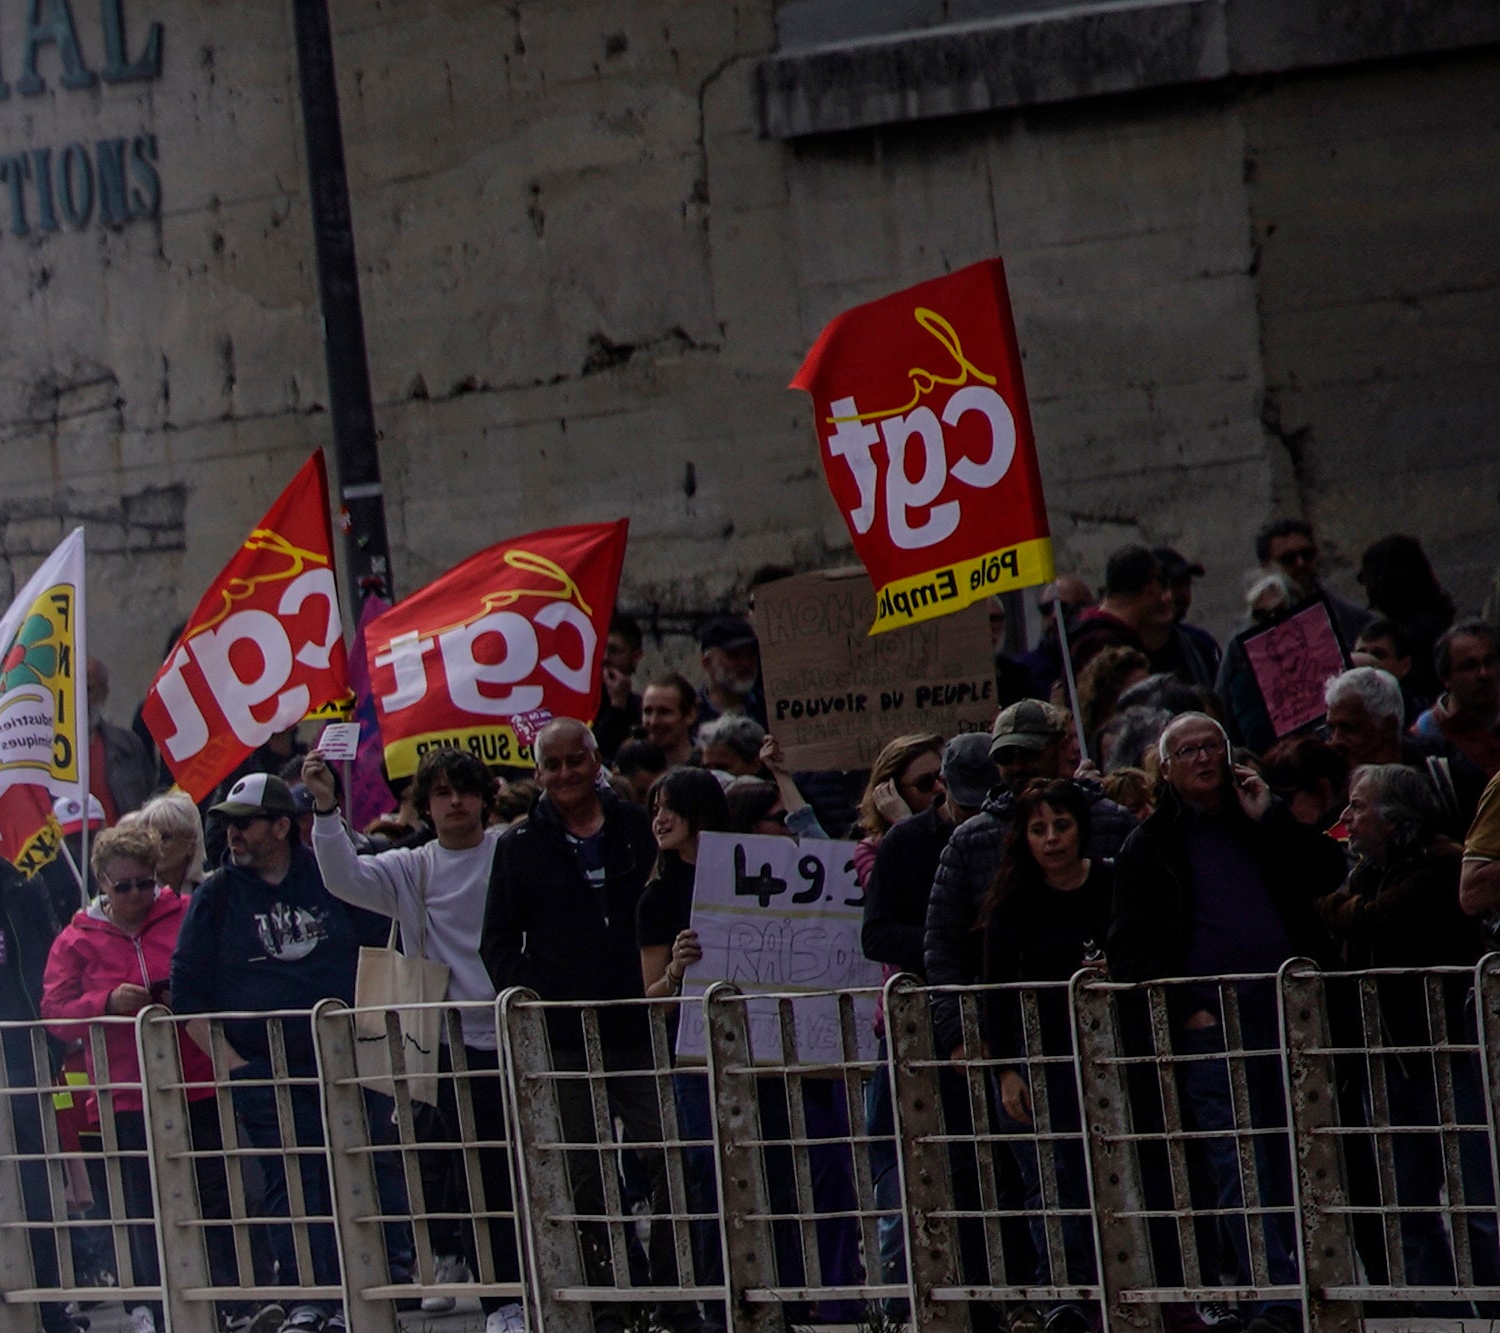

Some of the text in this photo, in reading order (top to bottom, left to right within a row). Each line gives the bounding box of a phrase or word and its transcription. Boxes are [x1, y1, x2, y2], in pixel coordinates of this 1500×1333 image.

[880, 691, 905, 713] DU
[916, 680, 994, 710] PEUPLE
[733, 843, 867, 907] 49.3
